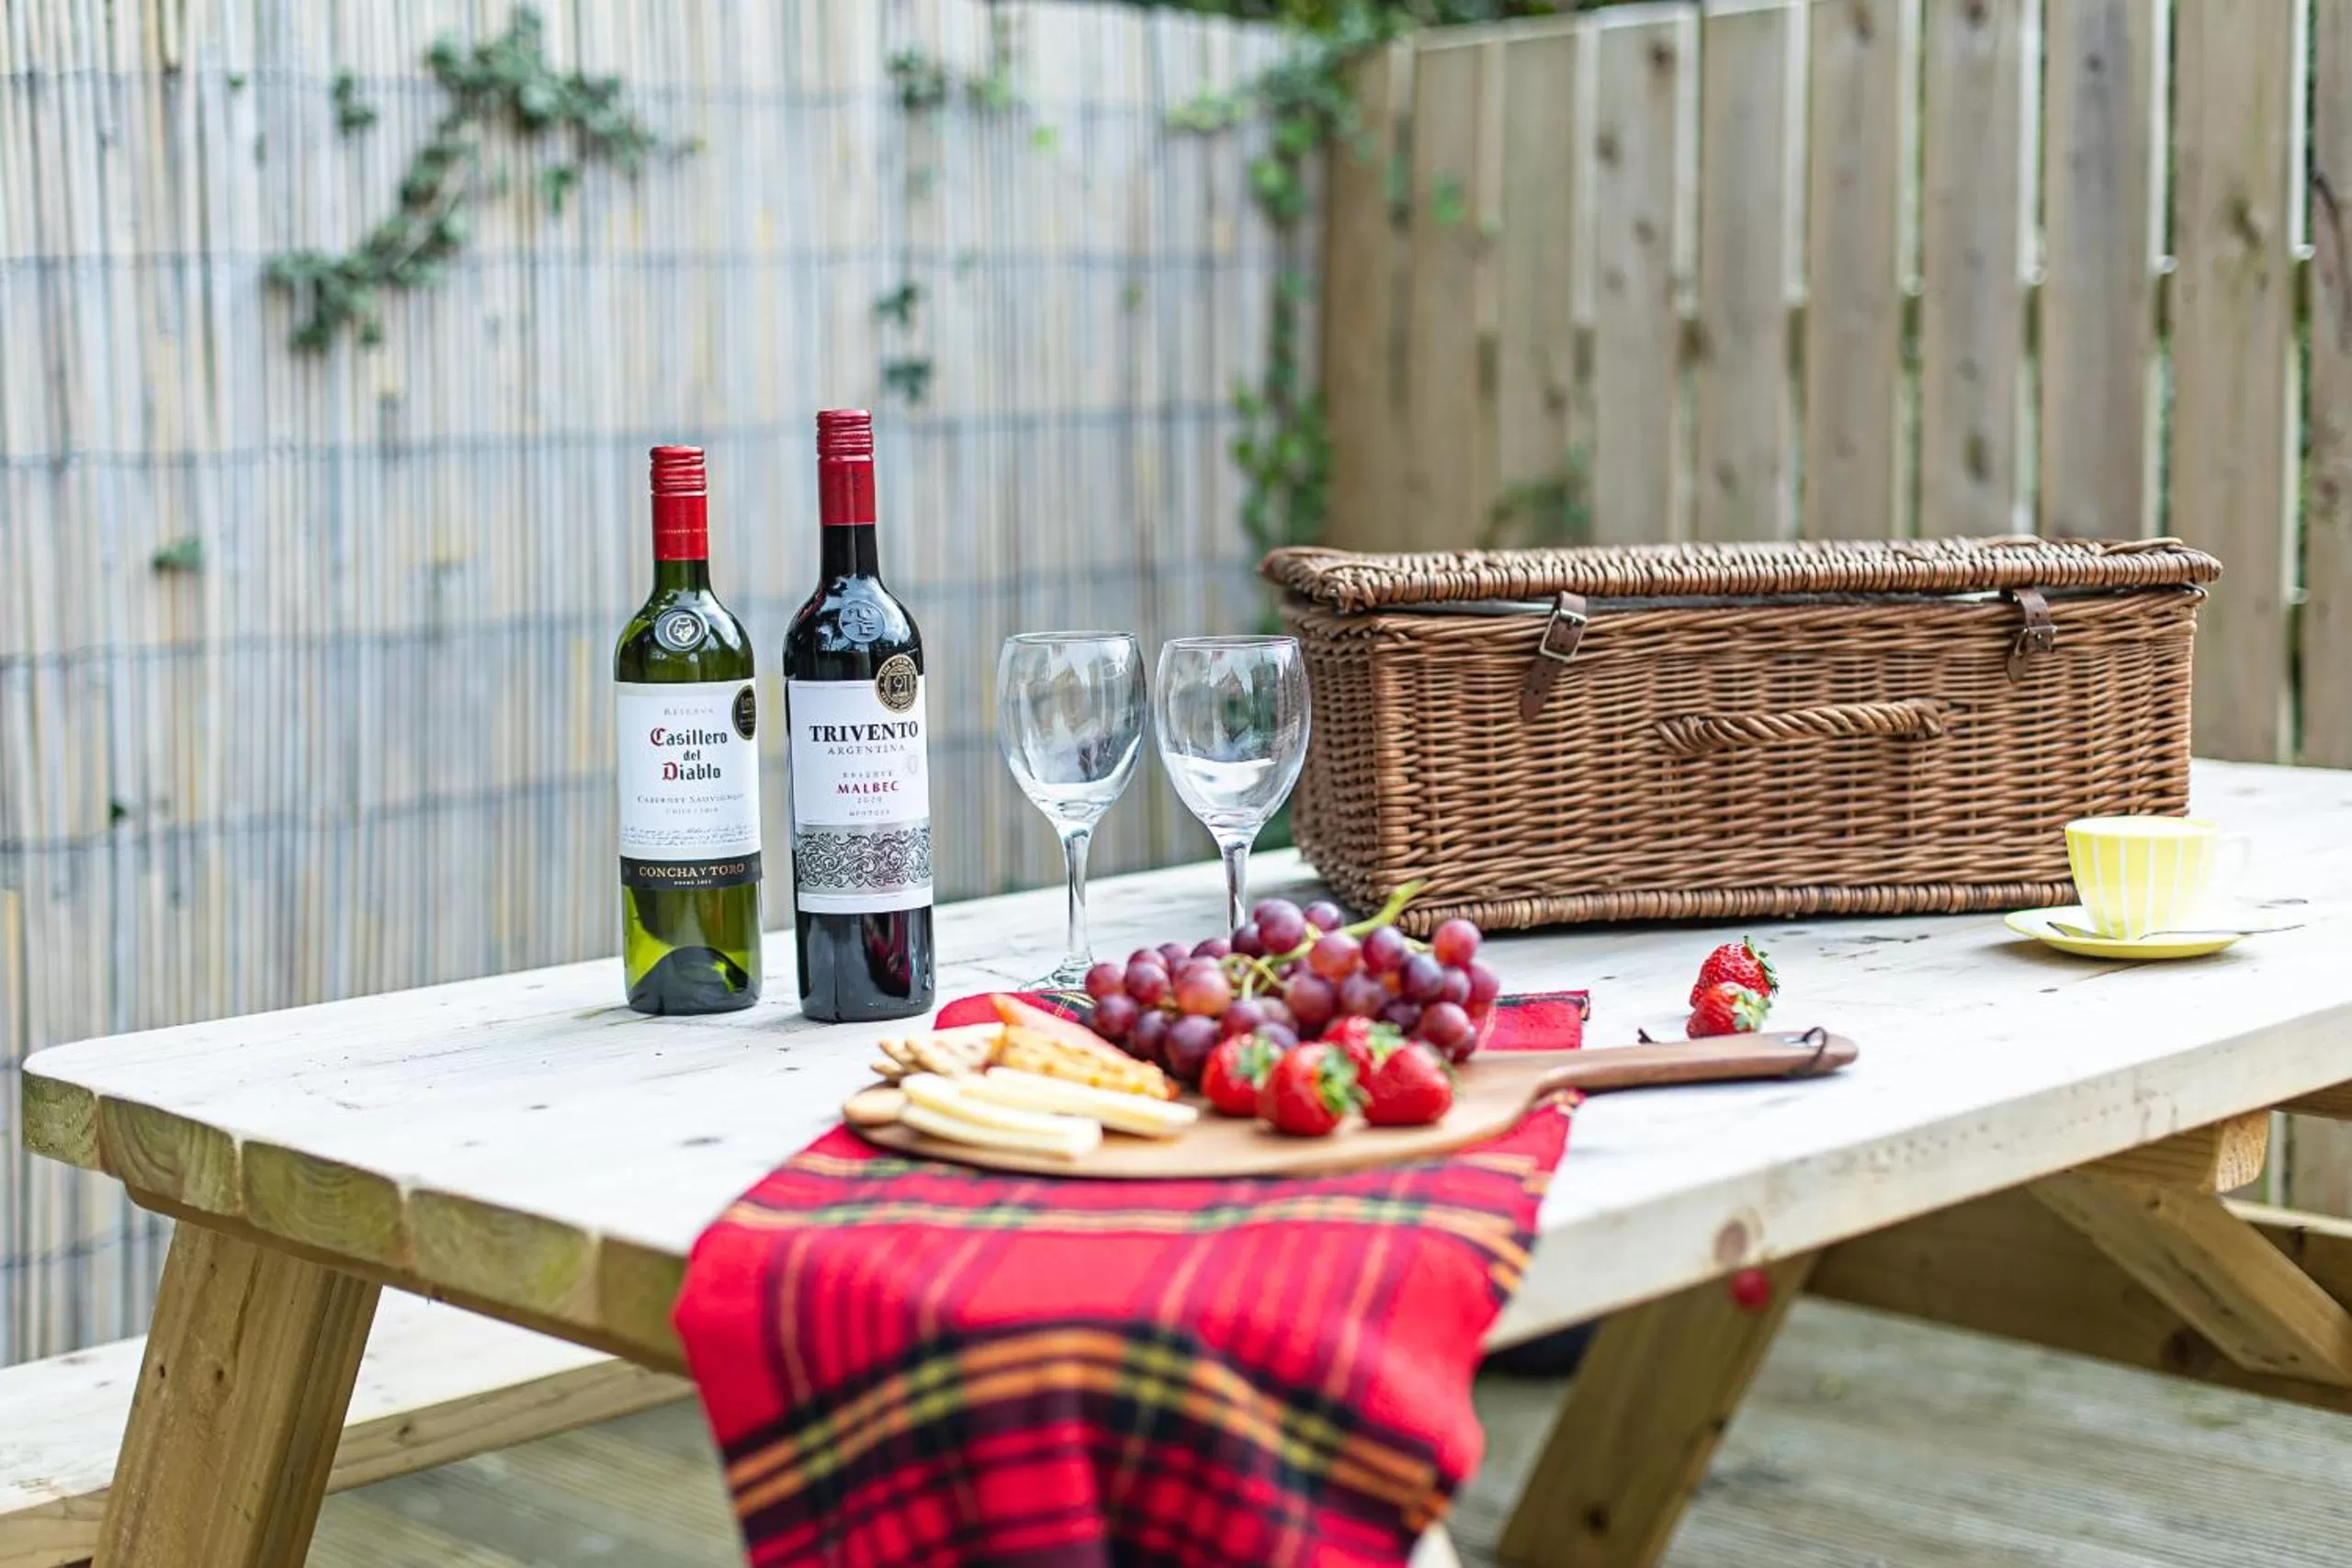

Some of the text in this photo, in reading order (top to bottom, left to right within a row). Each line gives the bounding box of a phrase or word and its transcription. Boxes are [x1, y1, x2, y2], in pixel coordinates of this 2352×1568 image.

[650, 727, 728, 746] Casillero
[808, 720, 919, 742] TRIVENTO
[684, 750, 701, 761] del
[828, 744, 906, 755] ARGENTINA
[662, 761, 721, 780] Diablo
[837, 781, 899, 794] MALBEC
[639, 863, 745, 877] CONCHA Y TORO
